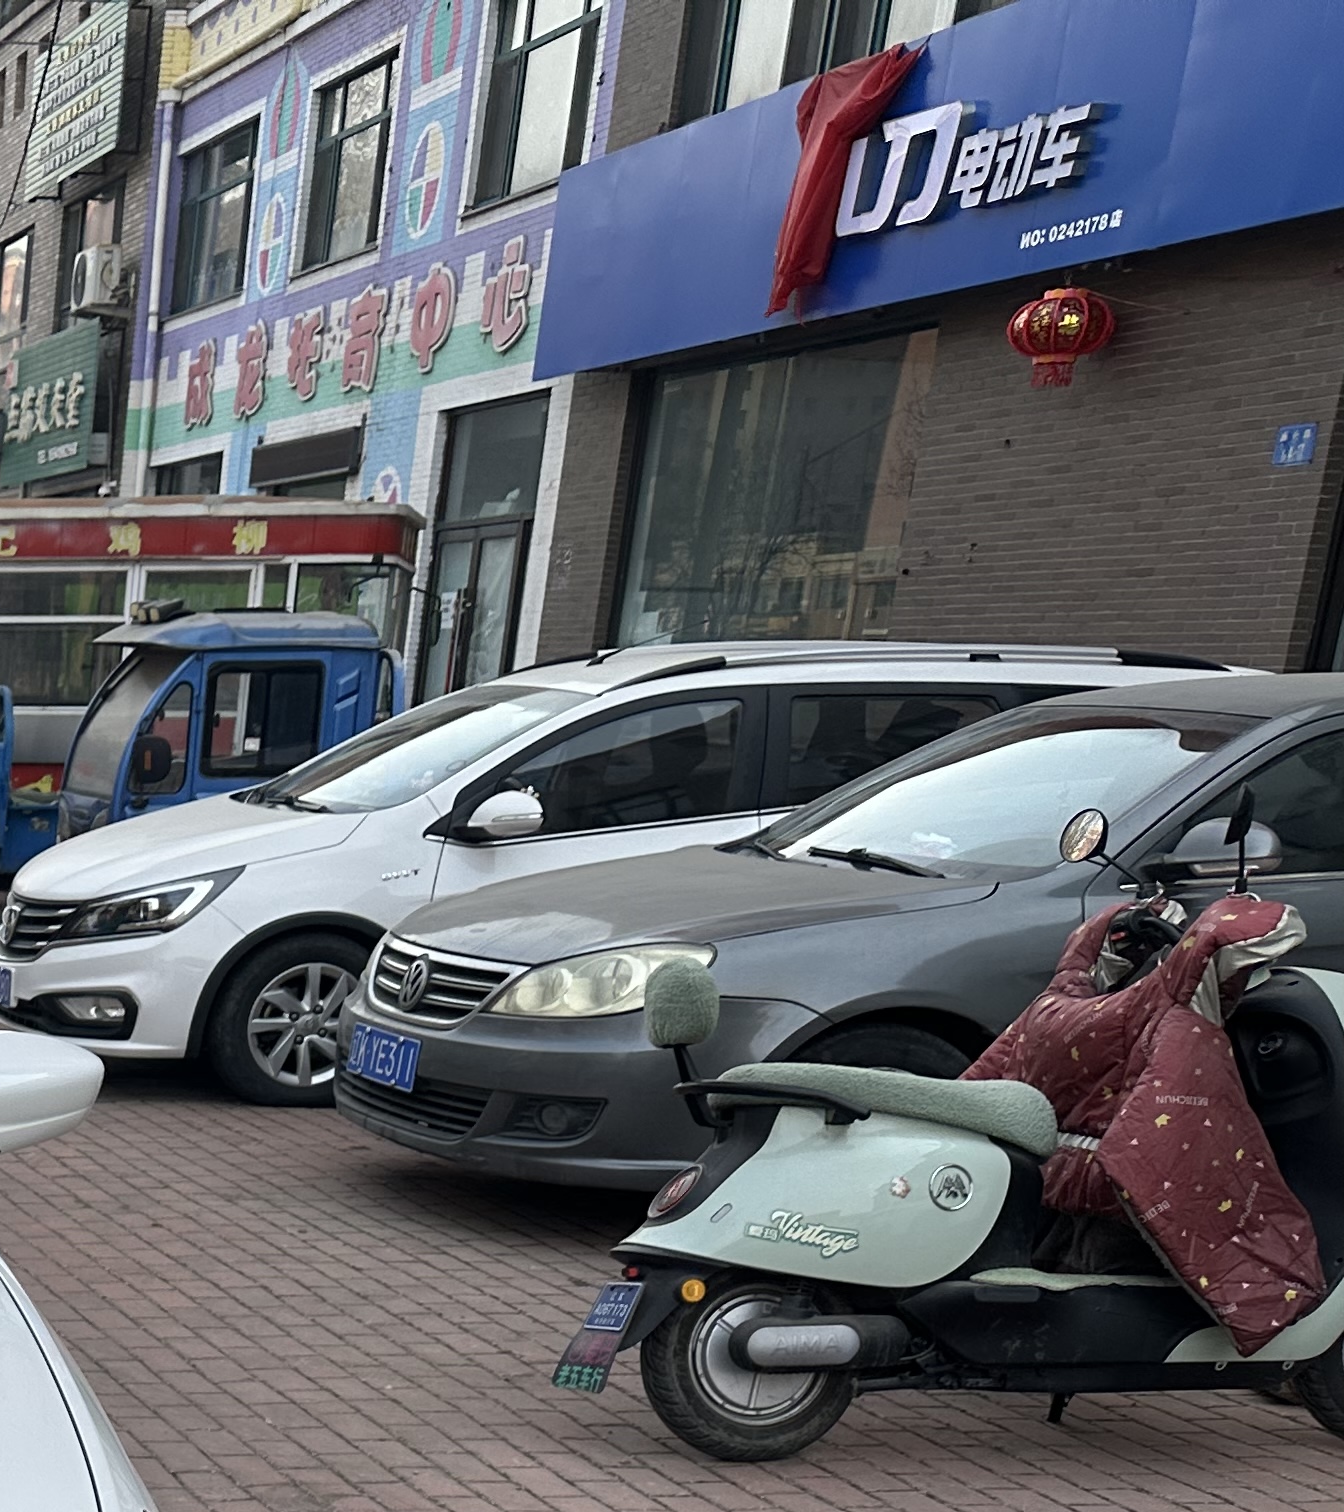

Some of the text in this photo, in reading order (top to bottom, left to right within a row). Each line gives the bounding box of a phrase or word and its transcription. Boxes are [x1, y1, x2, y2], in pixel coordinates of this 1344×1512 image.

[949, 102, 1092, 209] 电动车
[184, 234, 533, 430] 成龙托育中心
[771, 1210, 859, 1257] Vintage
[772, 1334, 840, 1355] AIMA
